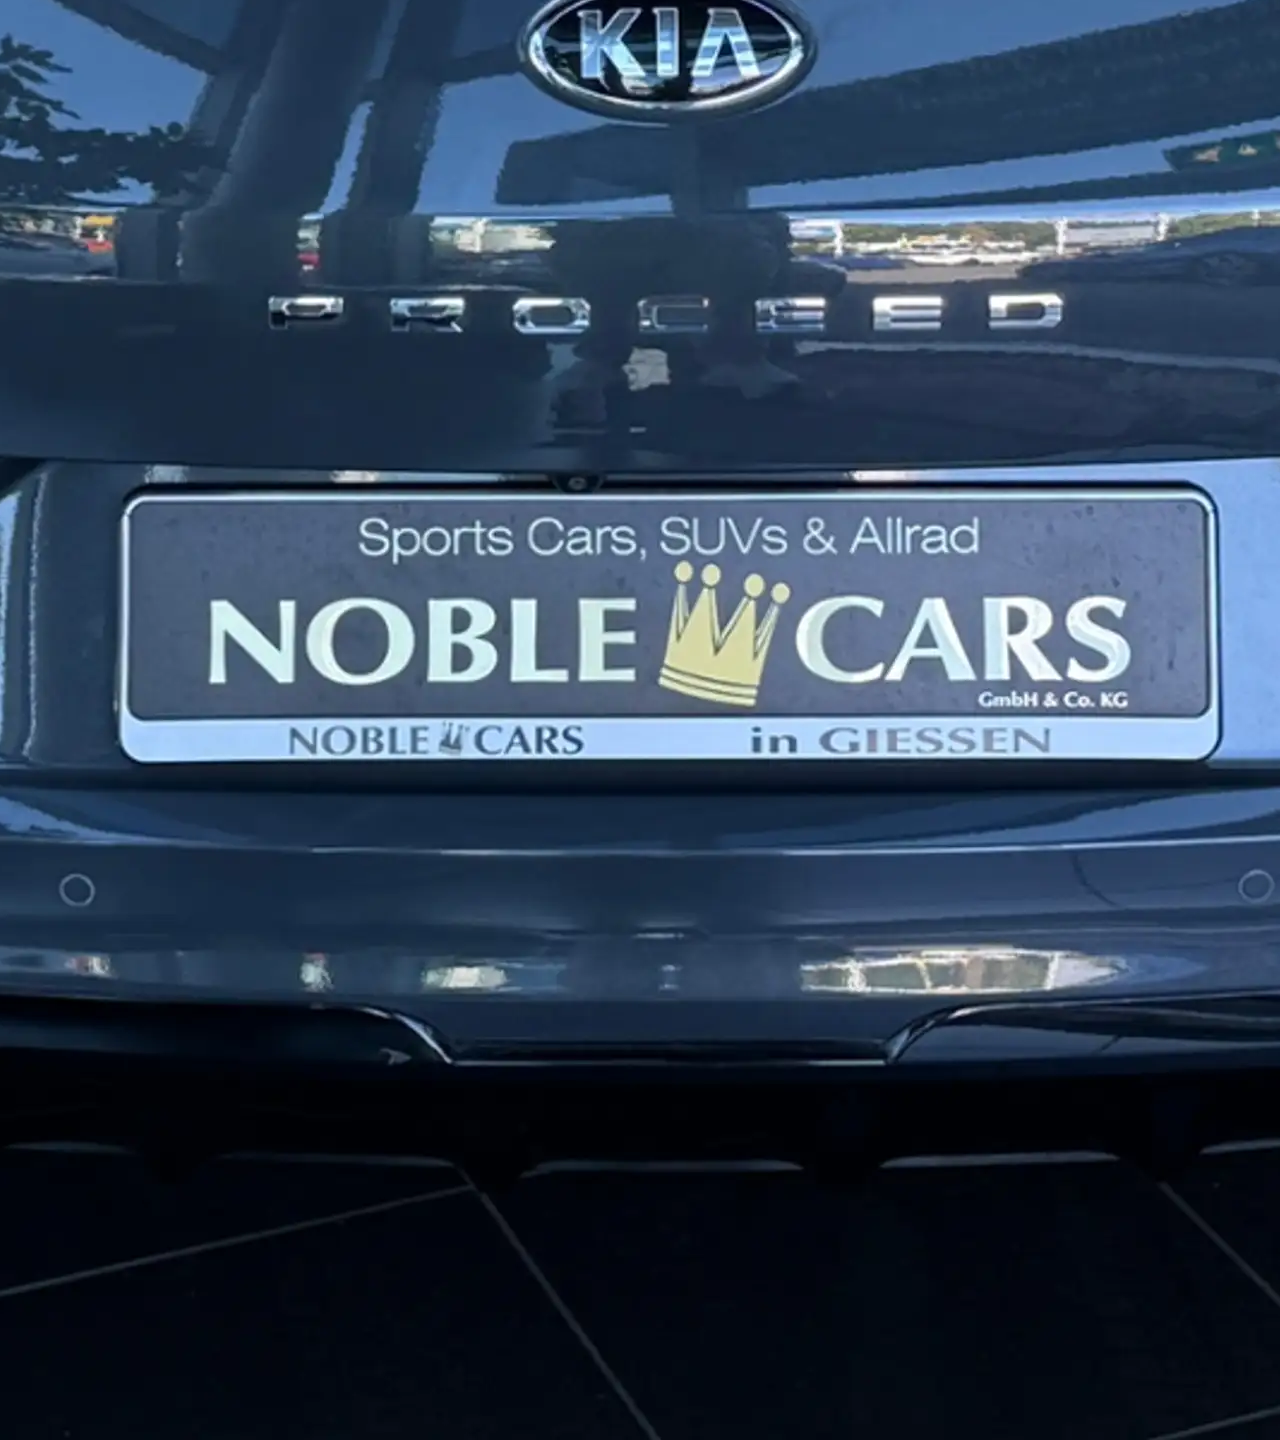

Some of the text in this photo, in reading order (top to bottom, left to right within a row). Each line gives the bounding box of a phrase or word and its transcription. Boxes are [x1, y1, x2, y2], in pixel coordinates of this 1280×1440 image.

[577, 7, 762, 79] KIA
[268, 292, 1064, 333] PROCEED
[358, 516, 980, 565] Sports Cars, SUVs & Allrad
[209, 595, 1132, 685] NOBLE CARS
[978, 691, 1129, 709] GmbH & Co. KG
[288, 725, 585, 755] NOBLE CARS
[751, 727, 1052, 754] in GIESSEN
